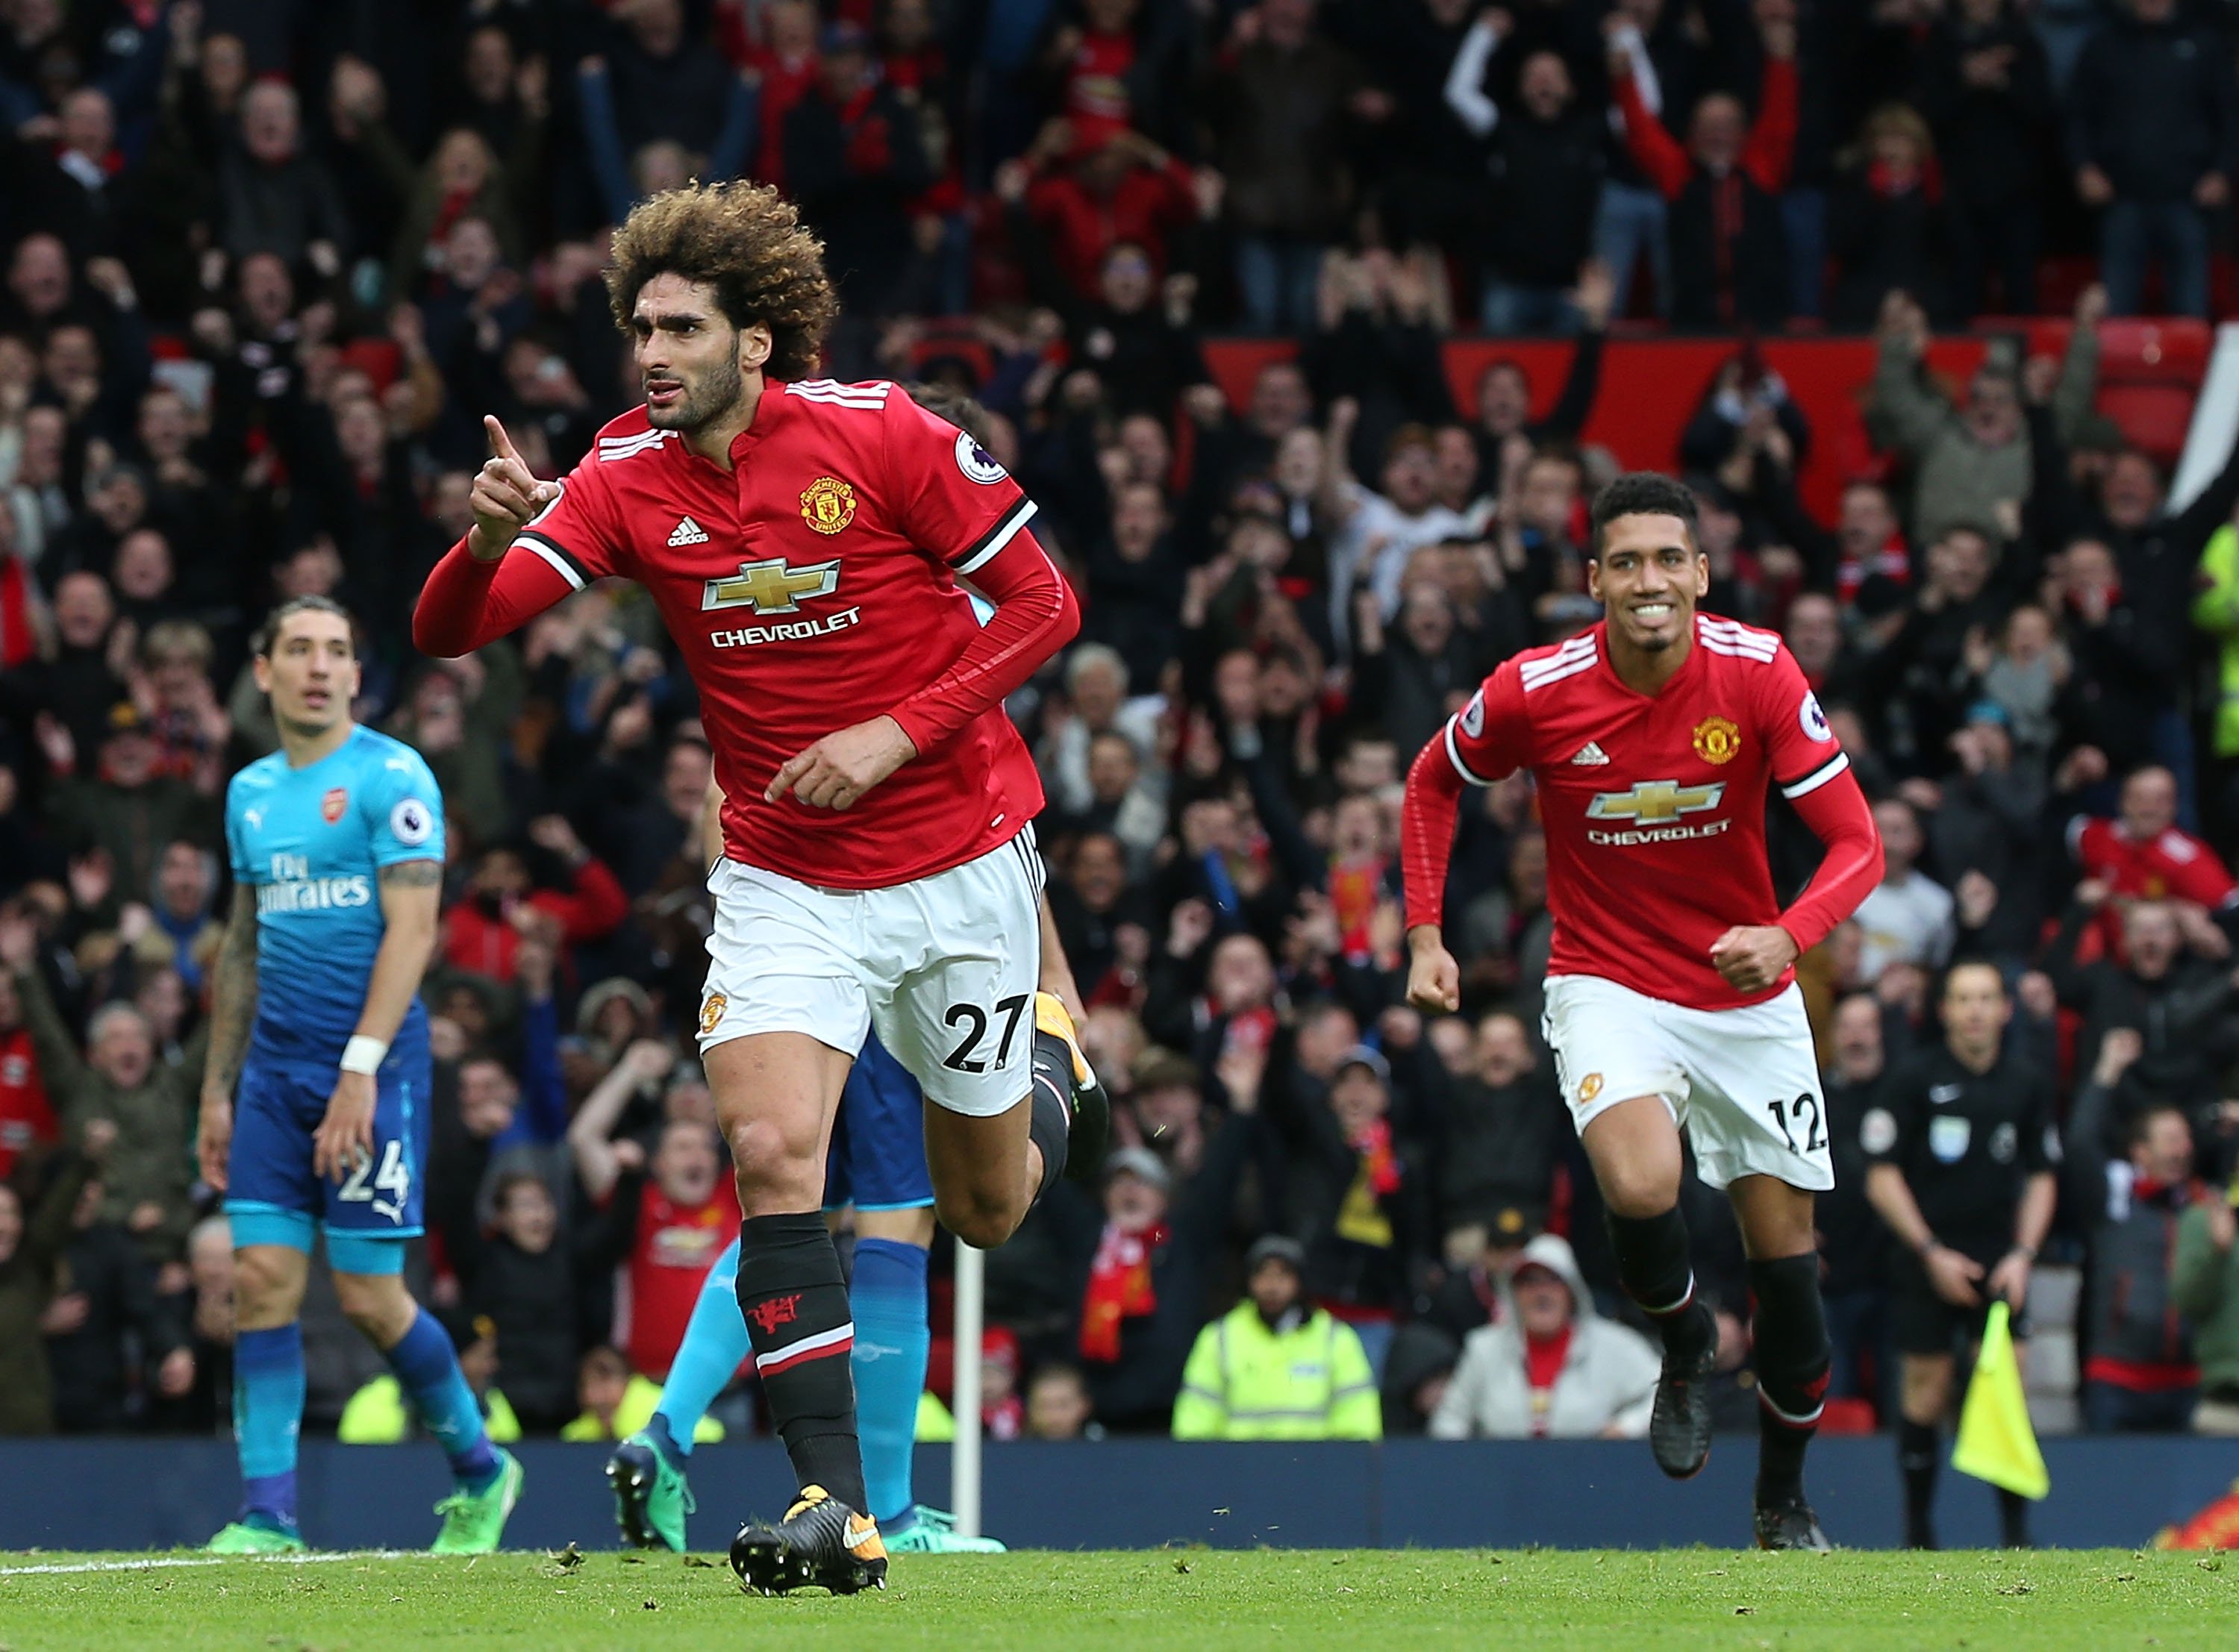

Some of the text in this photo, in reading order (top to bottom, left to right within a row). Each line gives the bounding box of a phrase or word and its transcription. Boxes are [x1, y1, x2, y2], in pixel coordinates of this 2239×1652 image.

[805, 481, 849, 503] MANCHESTER
[667, 533, 709, 547] adidas
[816, 517, 847, 531] UNITED
[711, 607, 860, 648] CHEVROLET
[1587, 819, 1731, 846] CHEVROLET
[942, 993, 1030, 1074] 27
[1768, 1092, 1828, 1156] 12
[337, 1139, 410, 1202] 24
